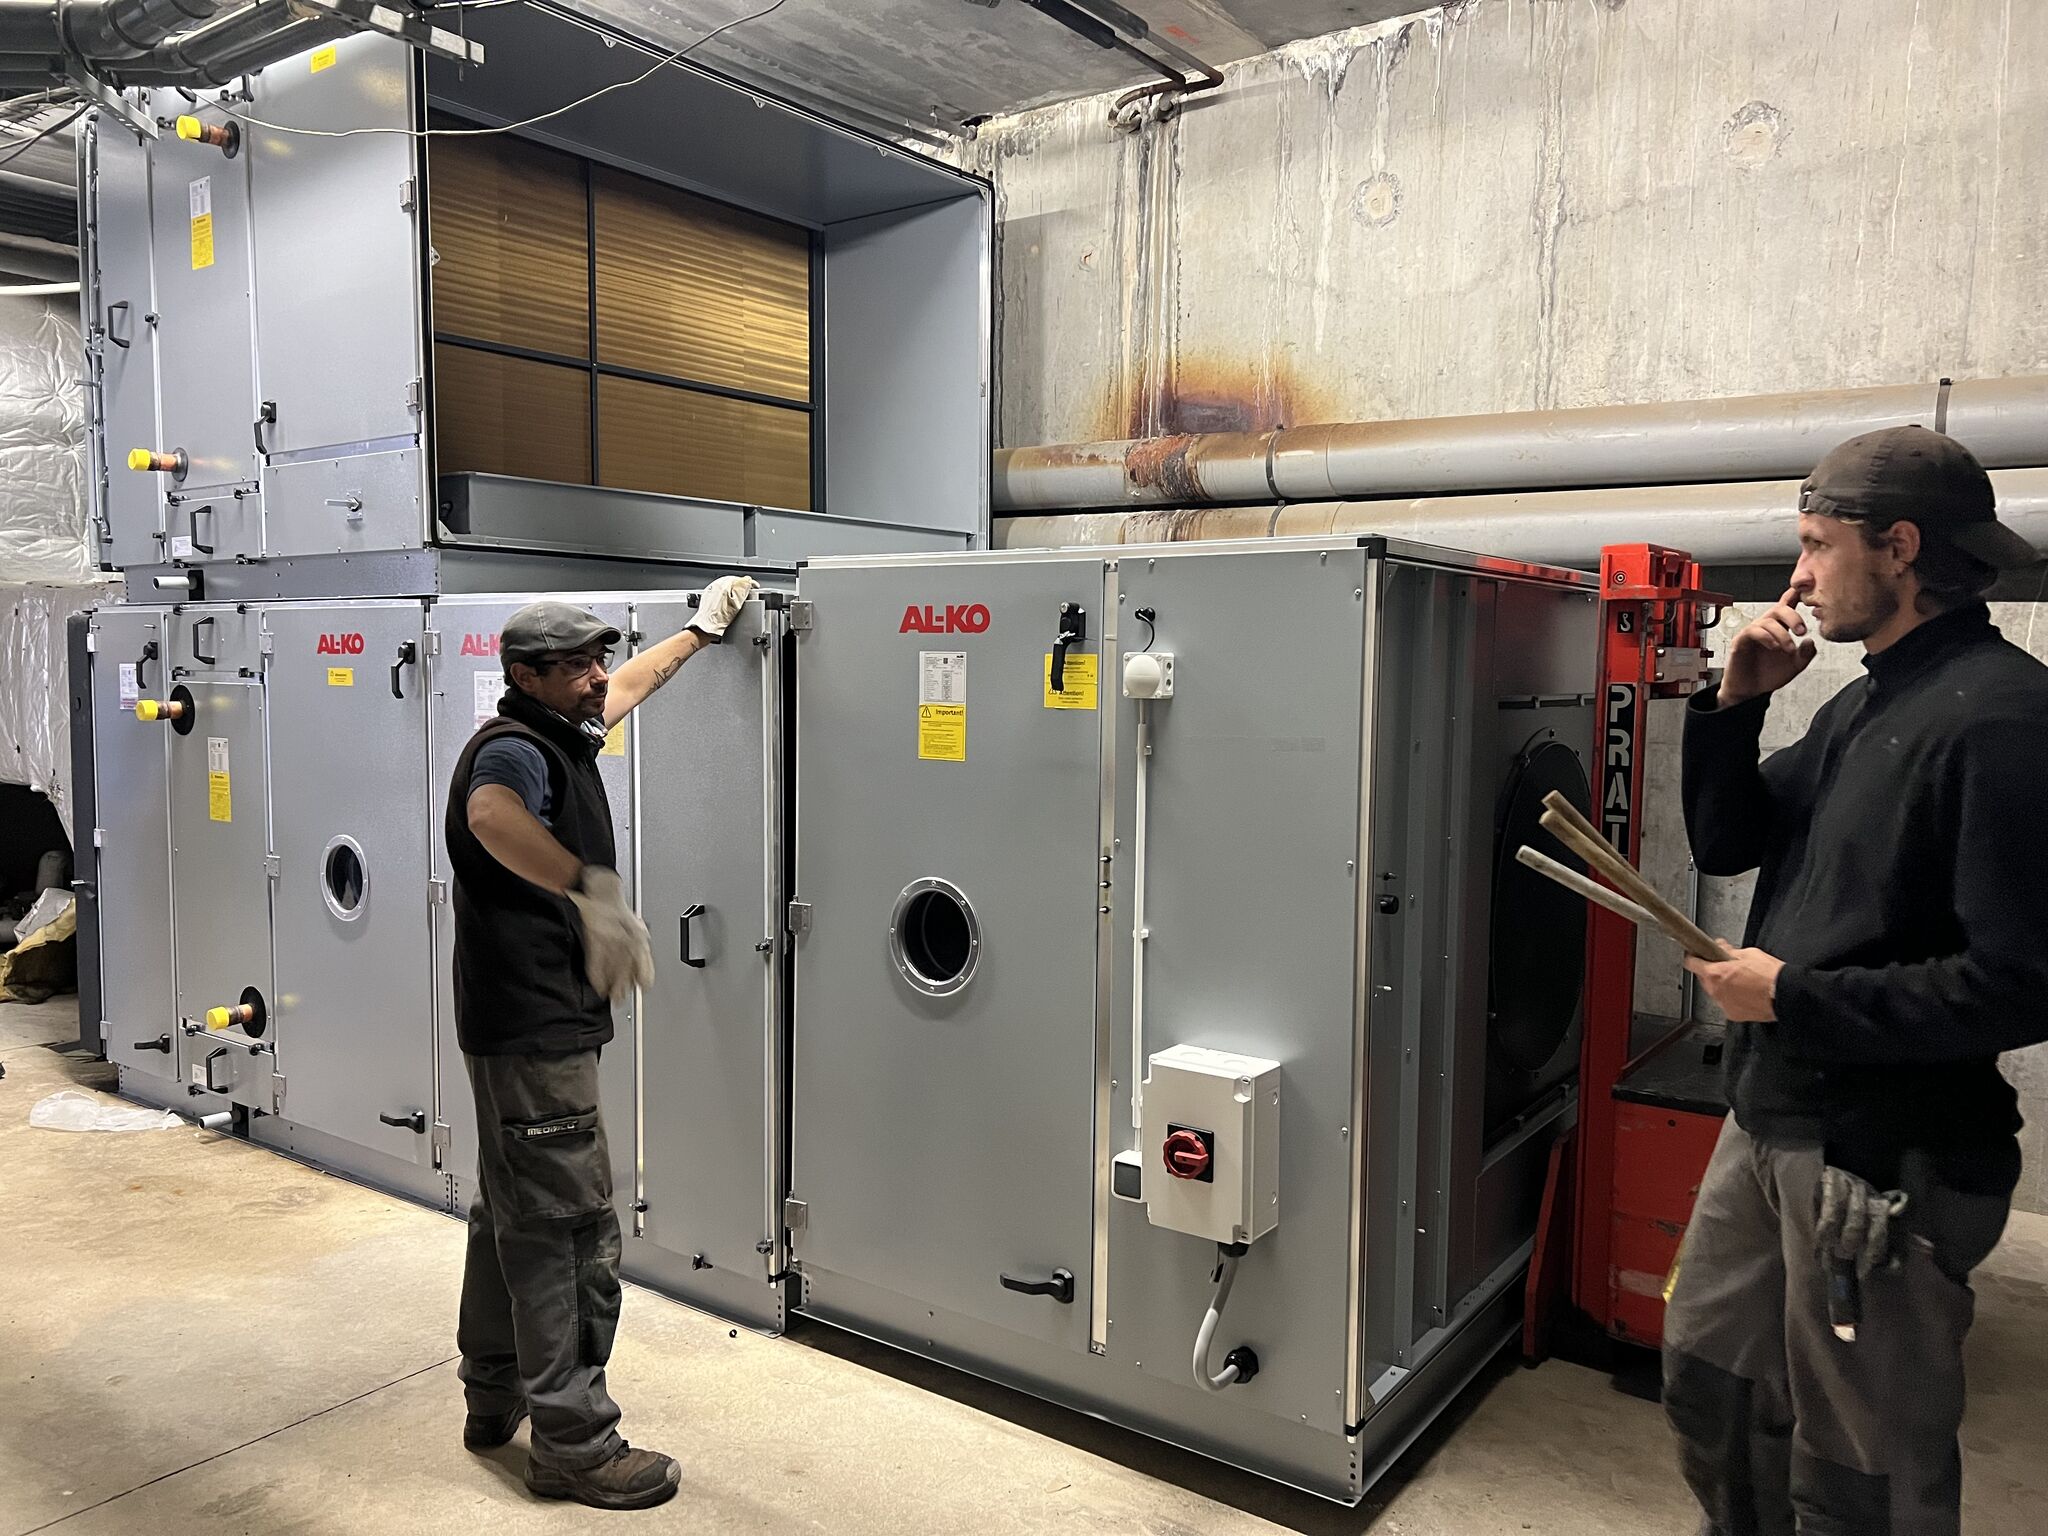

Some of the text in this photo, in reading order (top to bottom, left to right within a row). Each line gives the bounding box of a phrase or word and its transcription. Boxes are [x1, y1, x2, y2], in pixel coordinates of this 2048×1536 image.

[899, 604, 990, 634] AL-KO
[317, 633, 364, 654] AL-KO
[460, 633, 501, 656] AL-K
